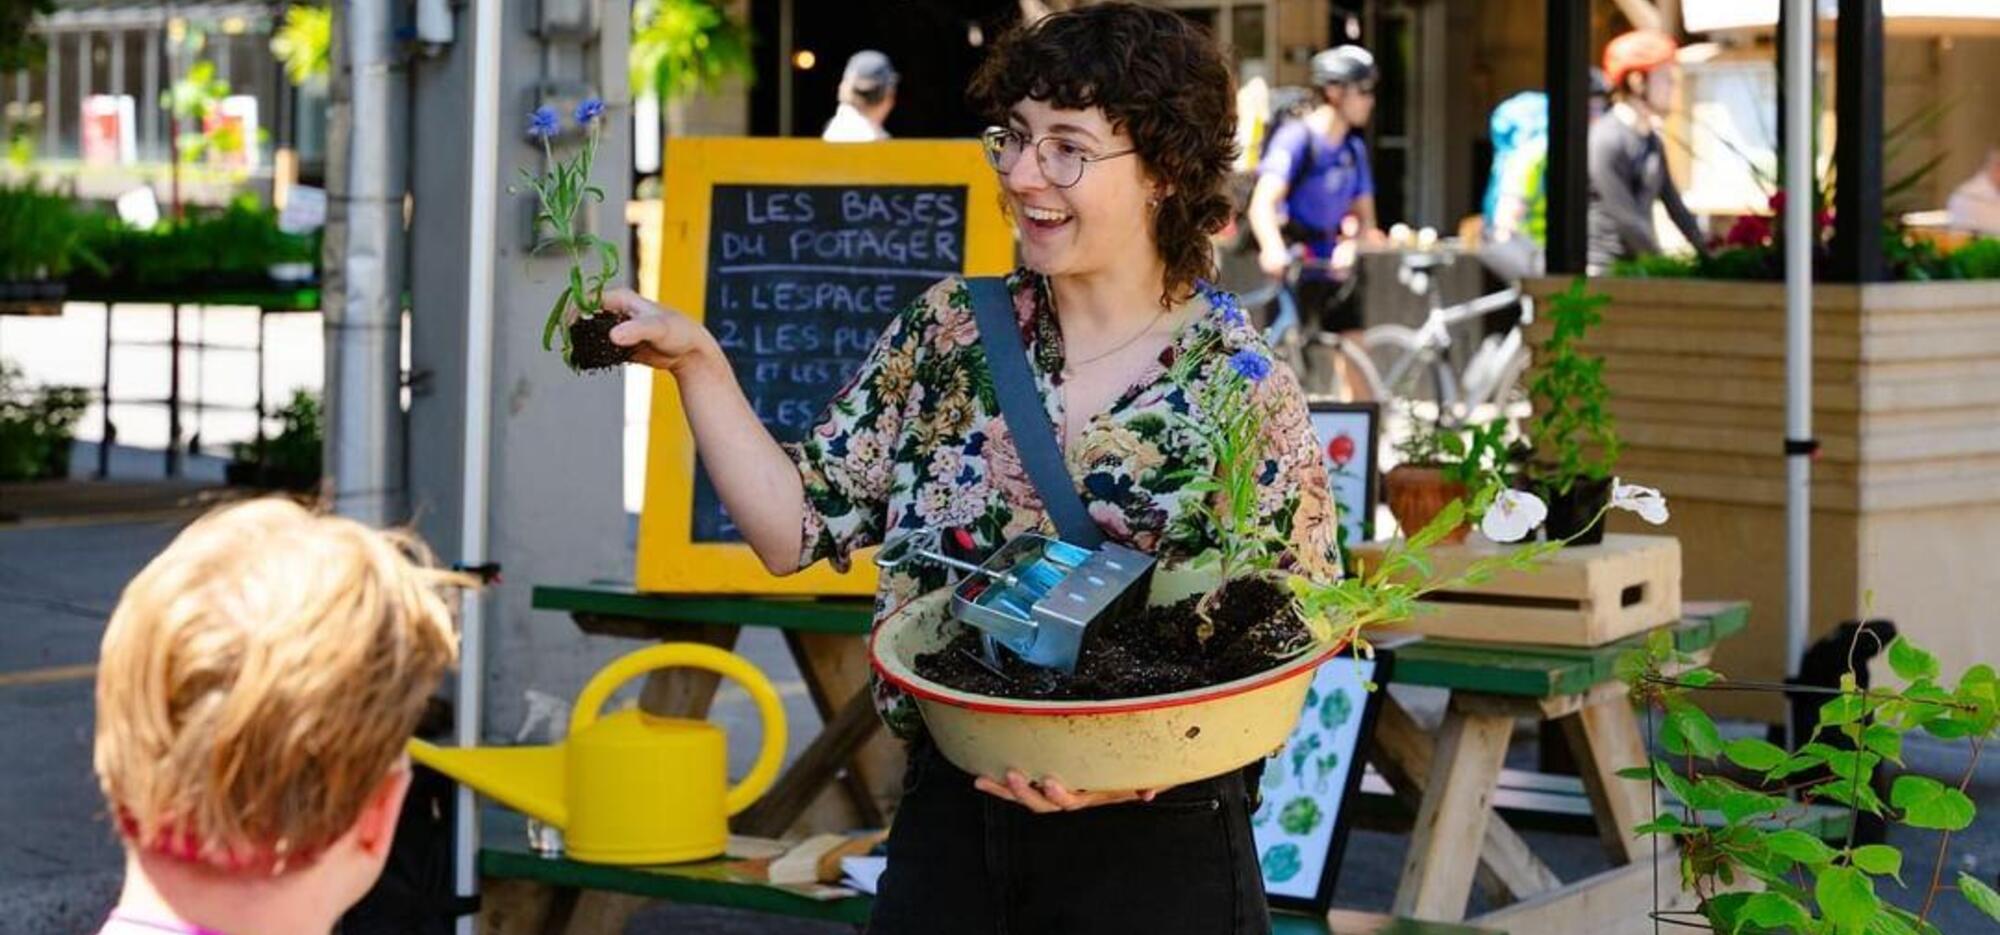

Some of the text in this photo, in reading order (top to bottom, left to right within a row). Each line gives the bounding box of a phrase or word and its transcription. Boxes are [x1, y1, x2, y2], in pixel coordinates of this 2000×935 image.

[745, 189, 960, 226] LES BASES
[722, 228, 958, 264] DU POTAGER
[754, 323, 820, 356] LES
[756, 360, 779, 384] ET
[790, 361, 830, 384] LES
[755, 396, 814, 430] LES
